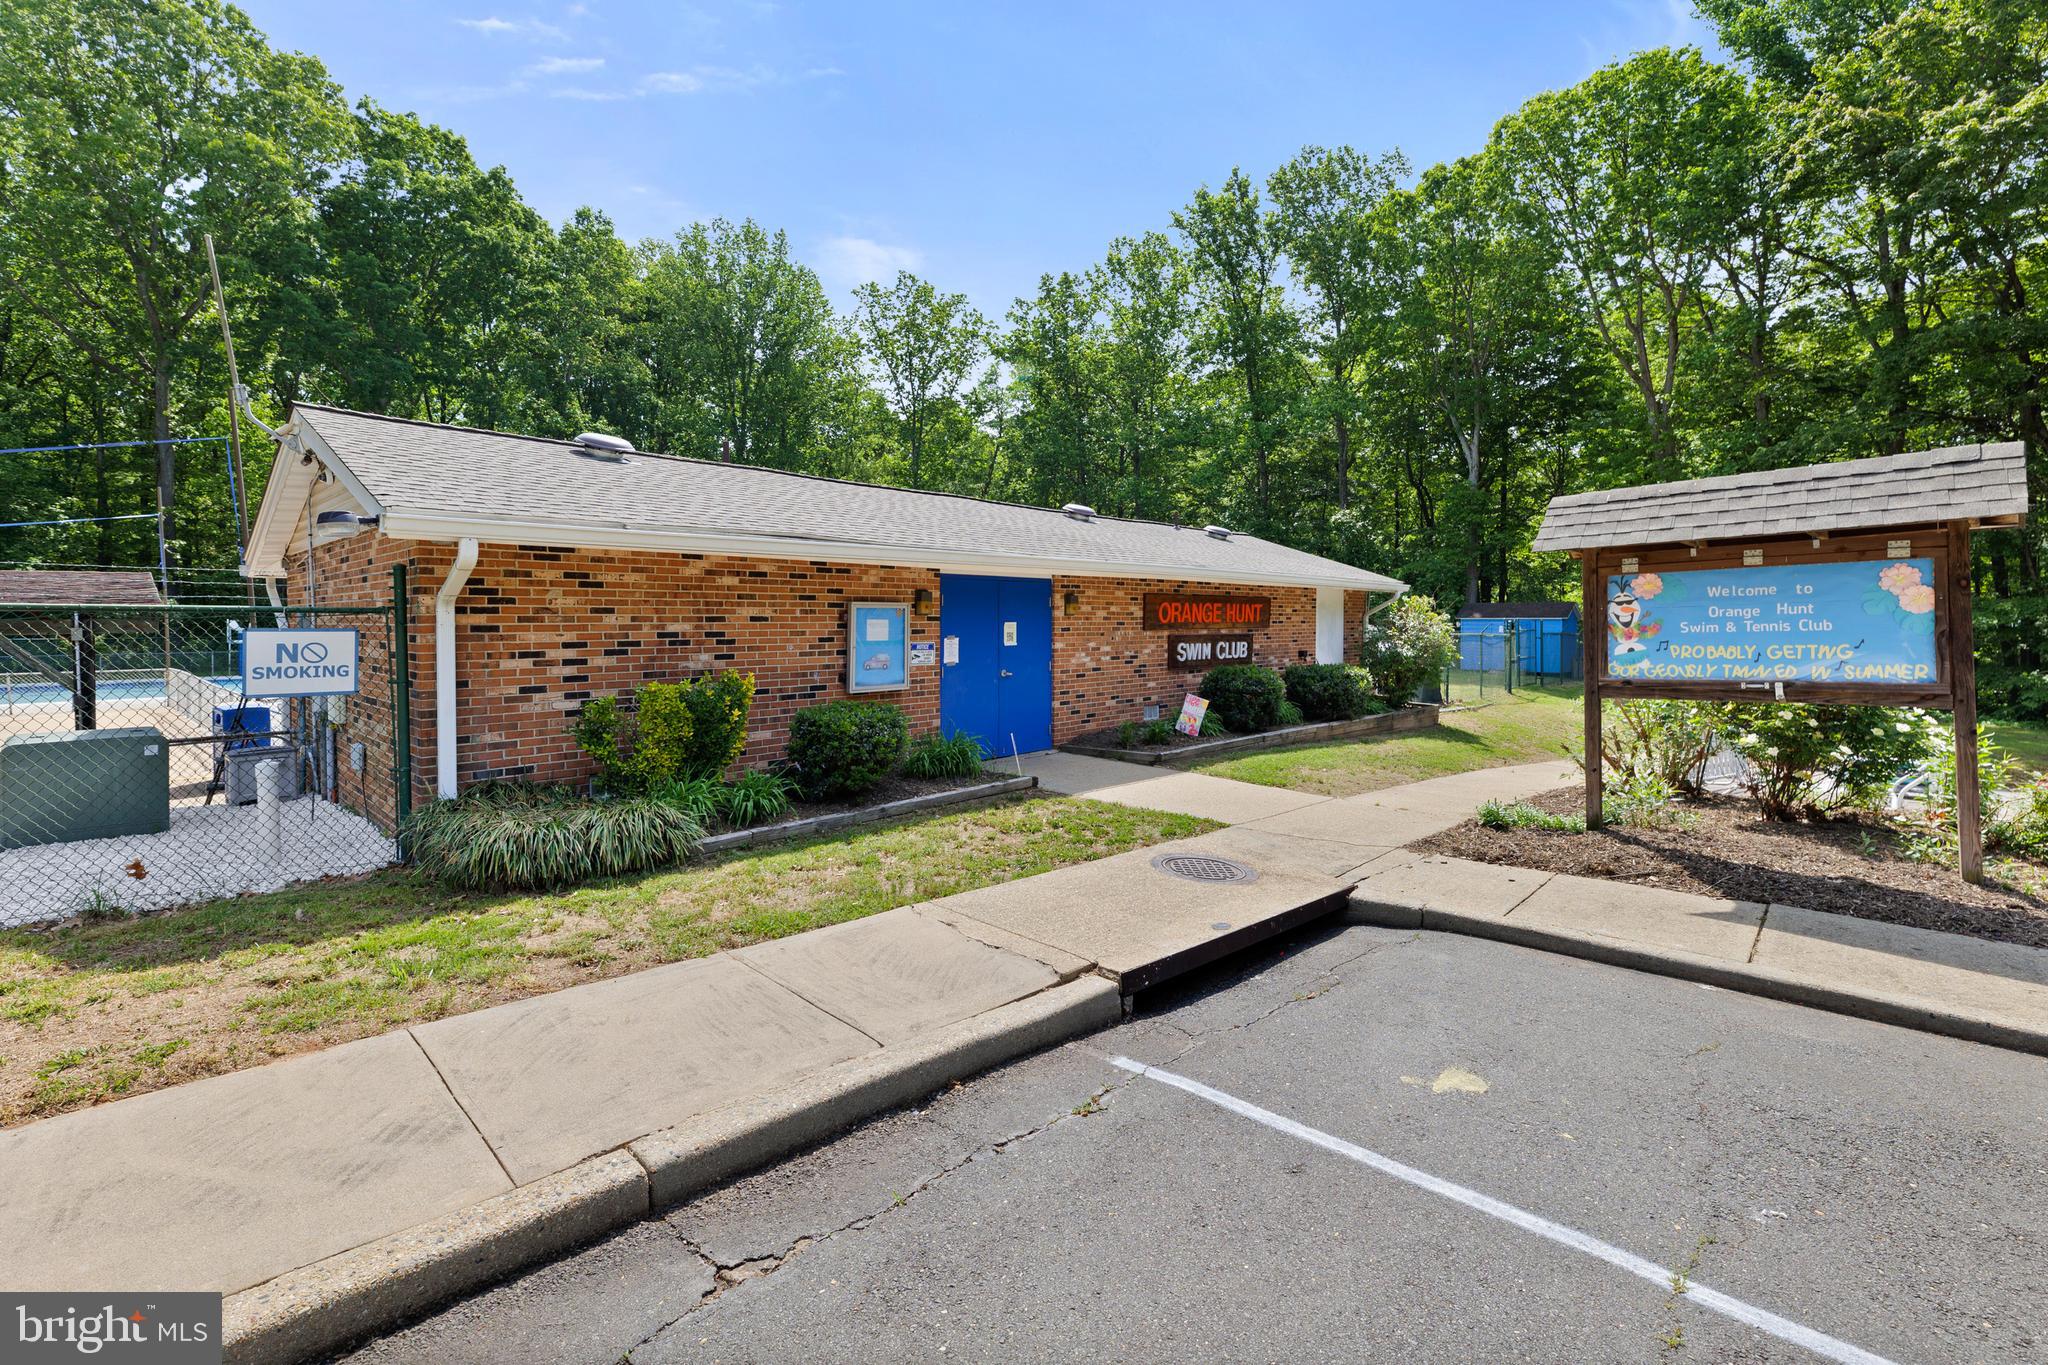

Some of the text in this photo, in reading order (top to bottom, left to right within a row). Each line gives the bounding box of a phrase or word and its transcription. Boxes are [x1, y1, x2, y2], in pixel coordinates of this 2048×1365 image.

[1707, 583, 1813, 597] Welcome to
[1158, 602, 1264, 624] ORANGE HUNT
[1708, 602, 1814, 619] Orange Hunt
[1680, 619, 1833, 633] Swim & Tennis Club
[1176, 641, 1248, 662] SWIM CLUB
[1669, 645, 1757, 660] PROBABLY
[252, 664, 349, 680] SMOKING
[1843, 663, 1929, 680] SUMMER
